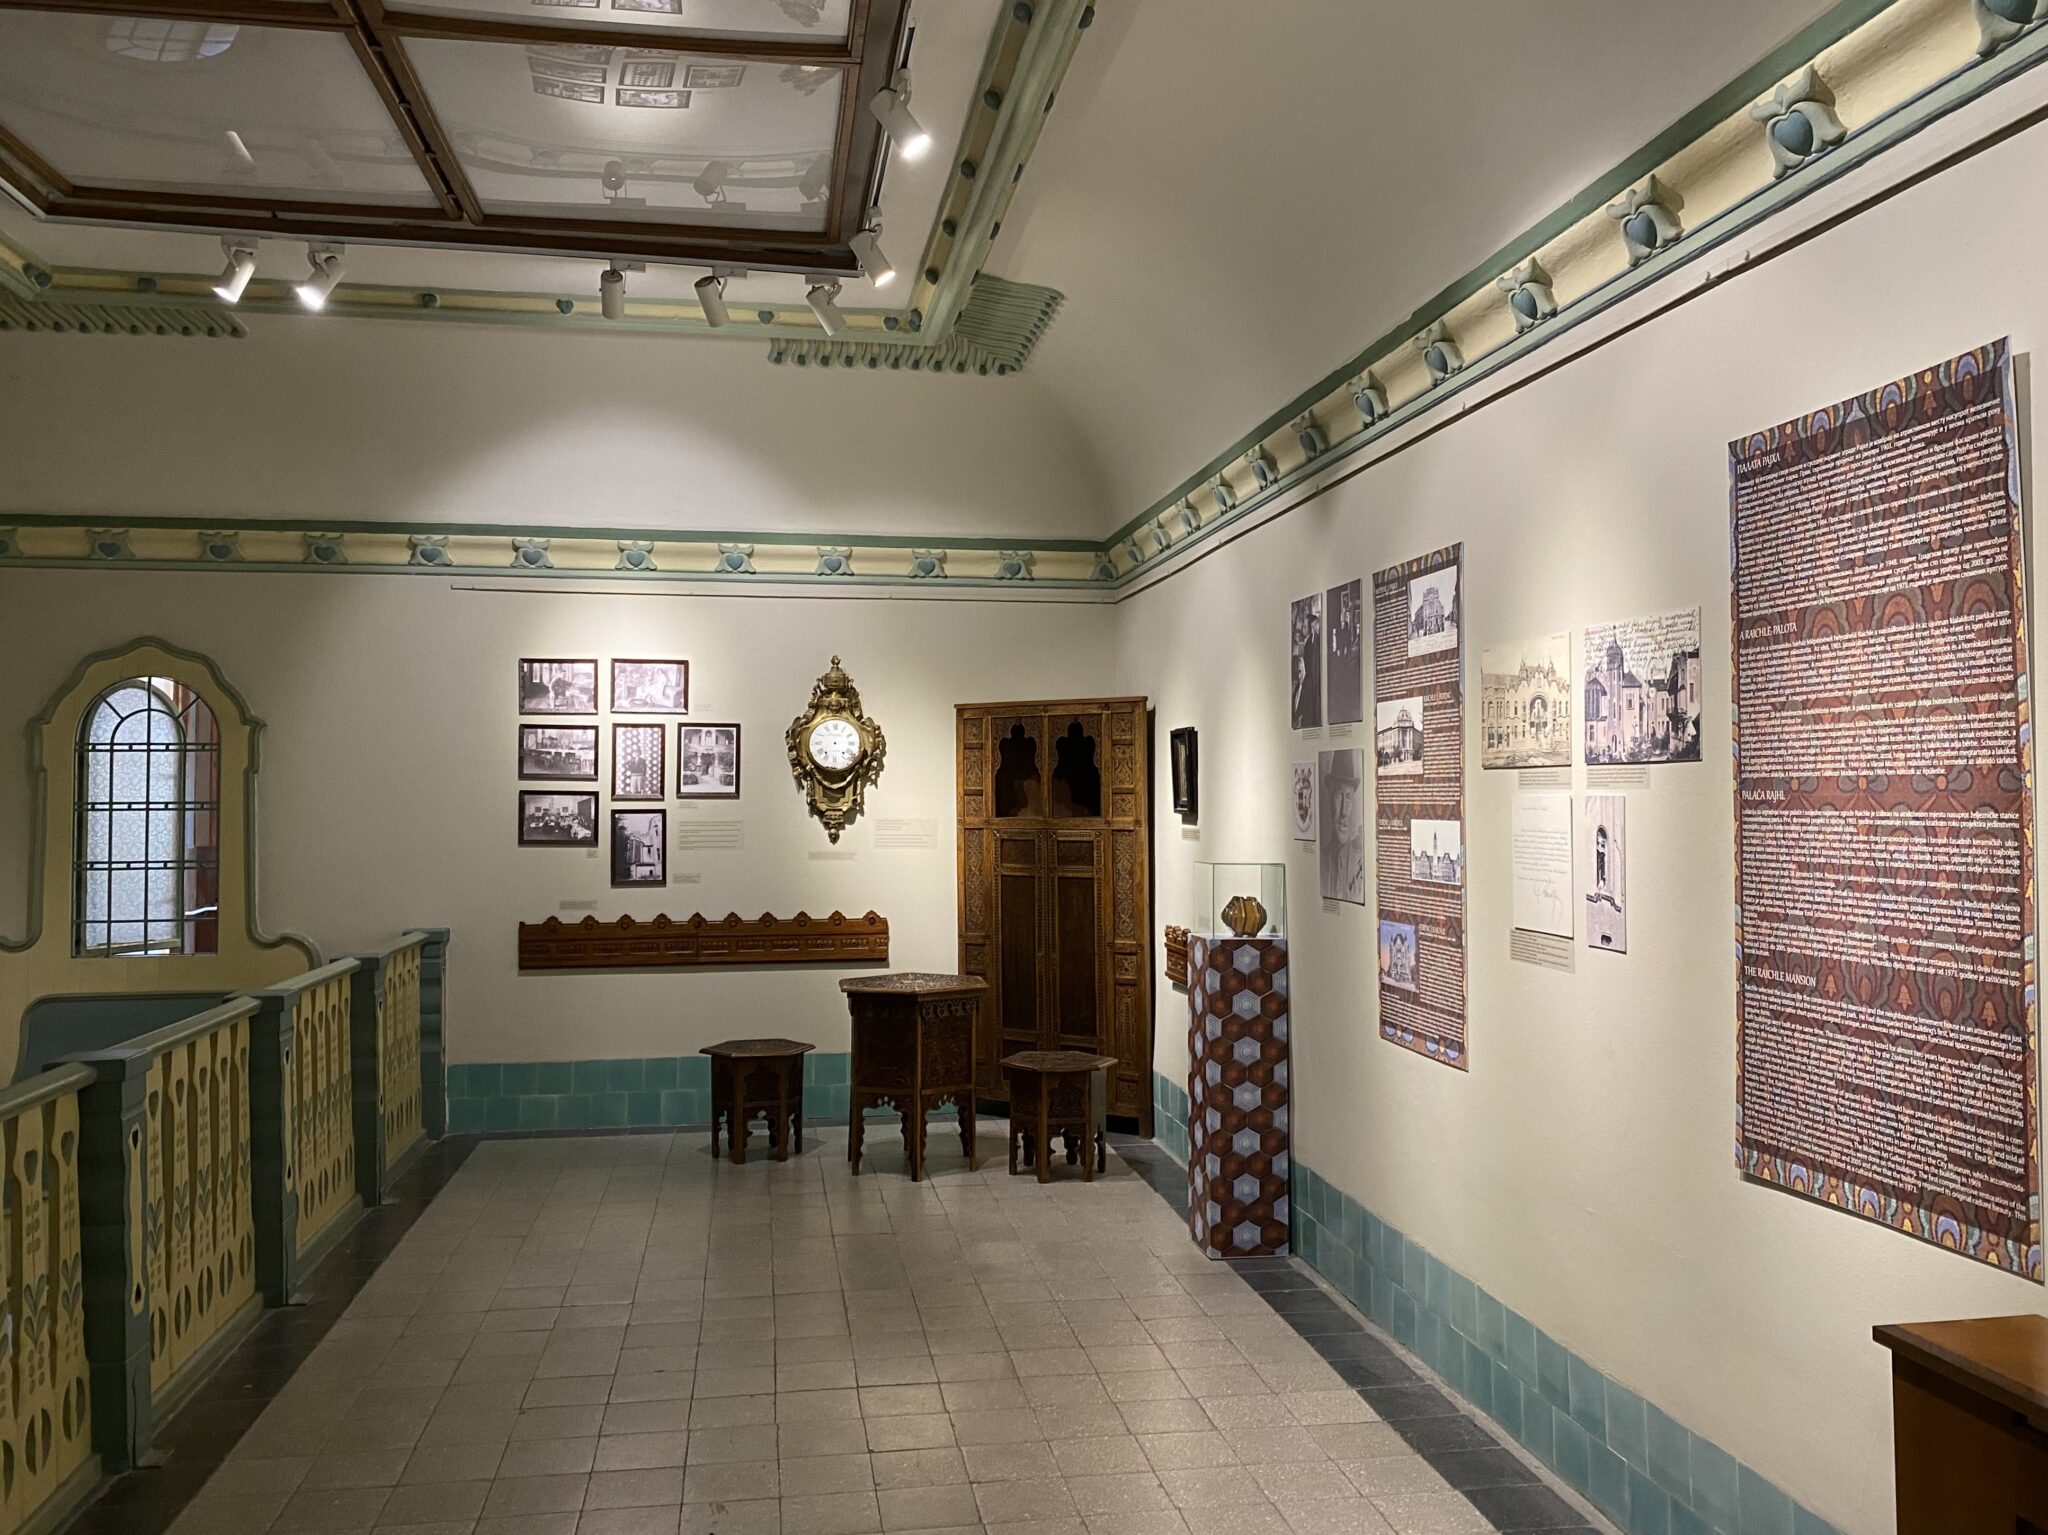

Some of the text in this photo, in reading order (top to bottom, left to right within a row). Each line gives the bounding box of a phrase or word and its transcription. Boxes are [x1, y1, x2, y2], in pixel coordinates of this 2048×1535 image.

[1744, 965, 1816, 987] THE RAICHLE MANSION
